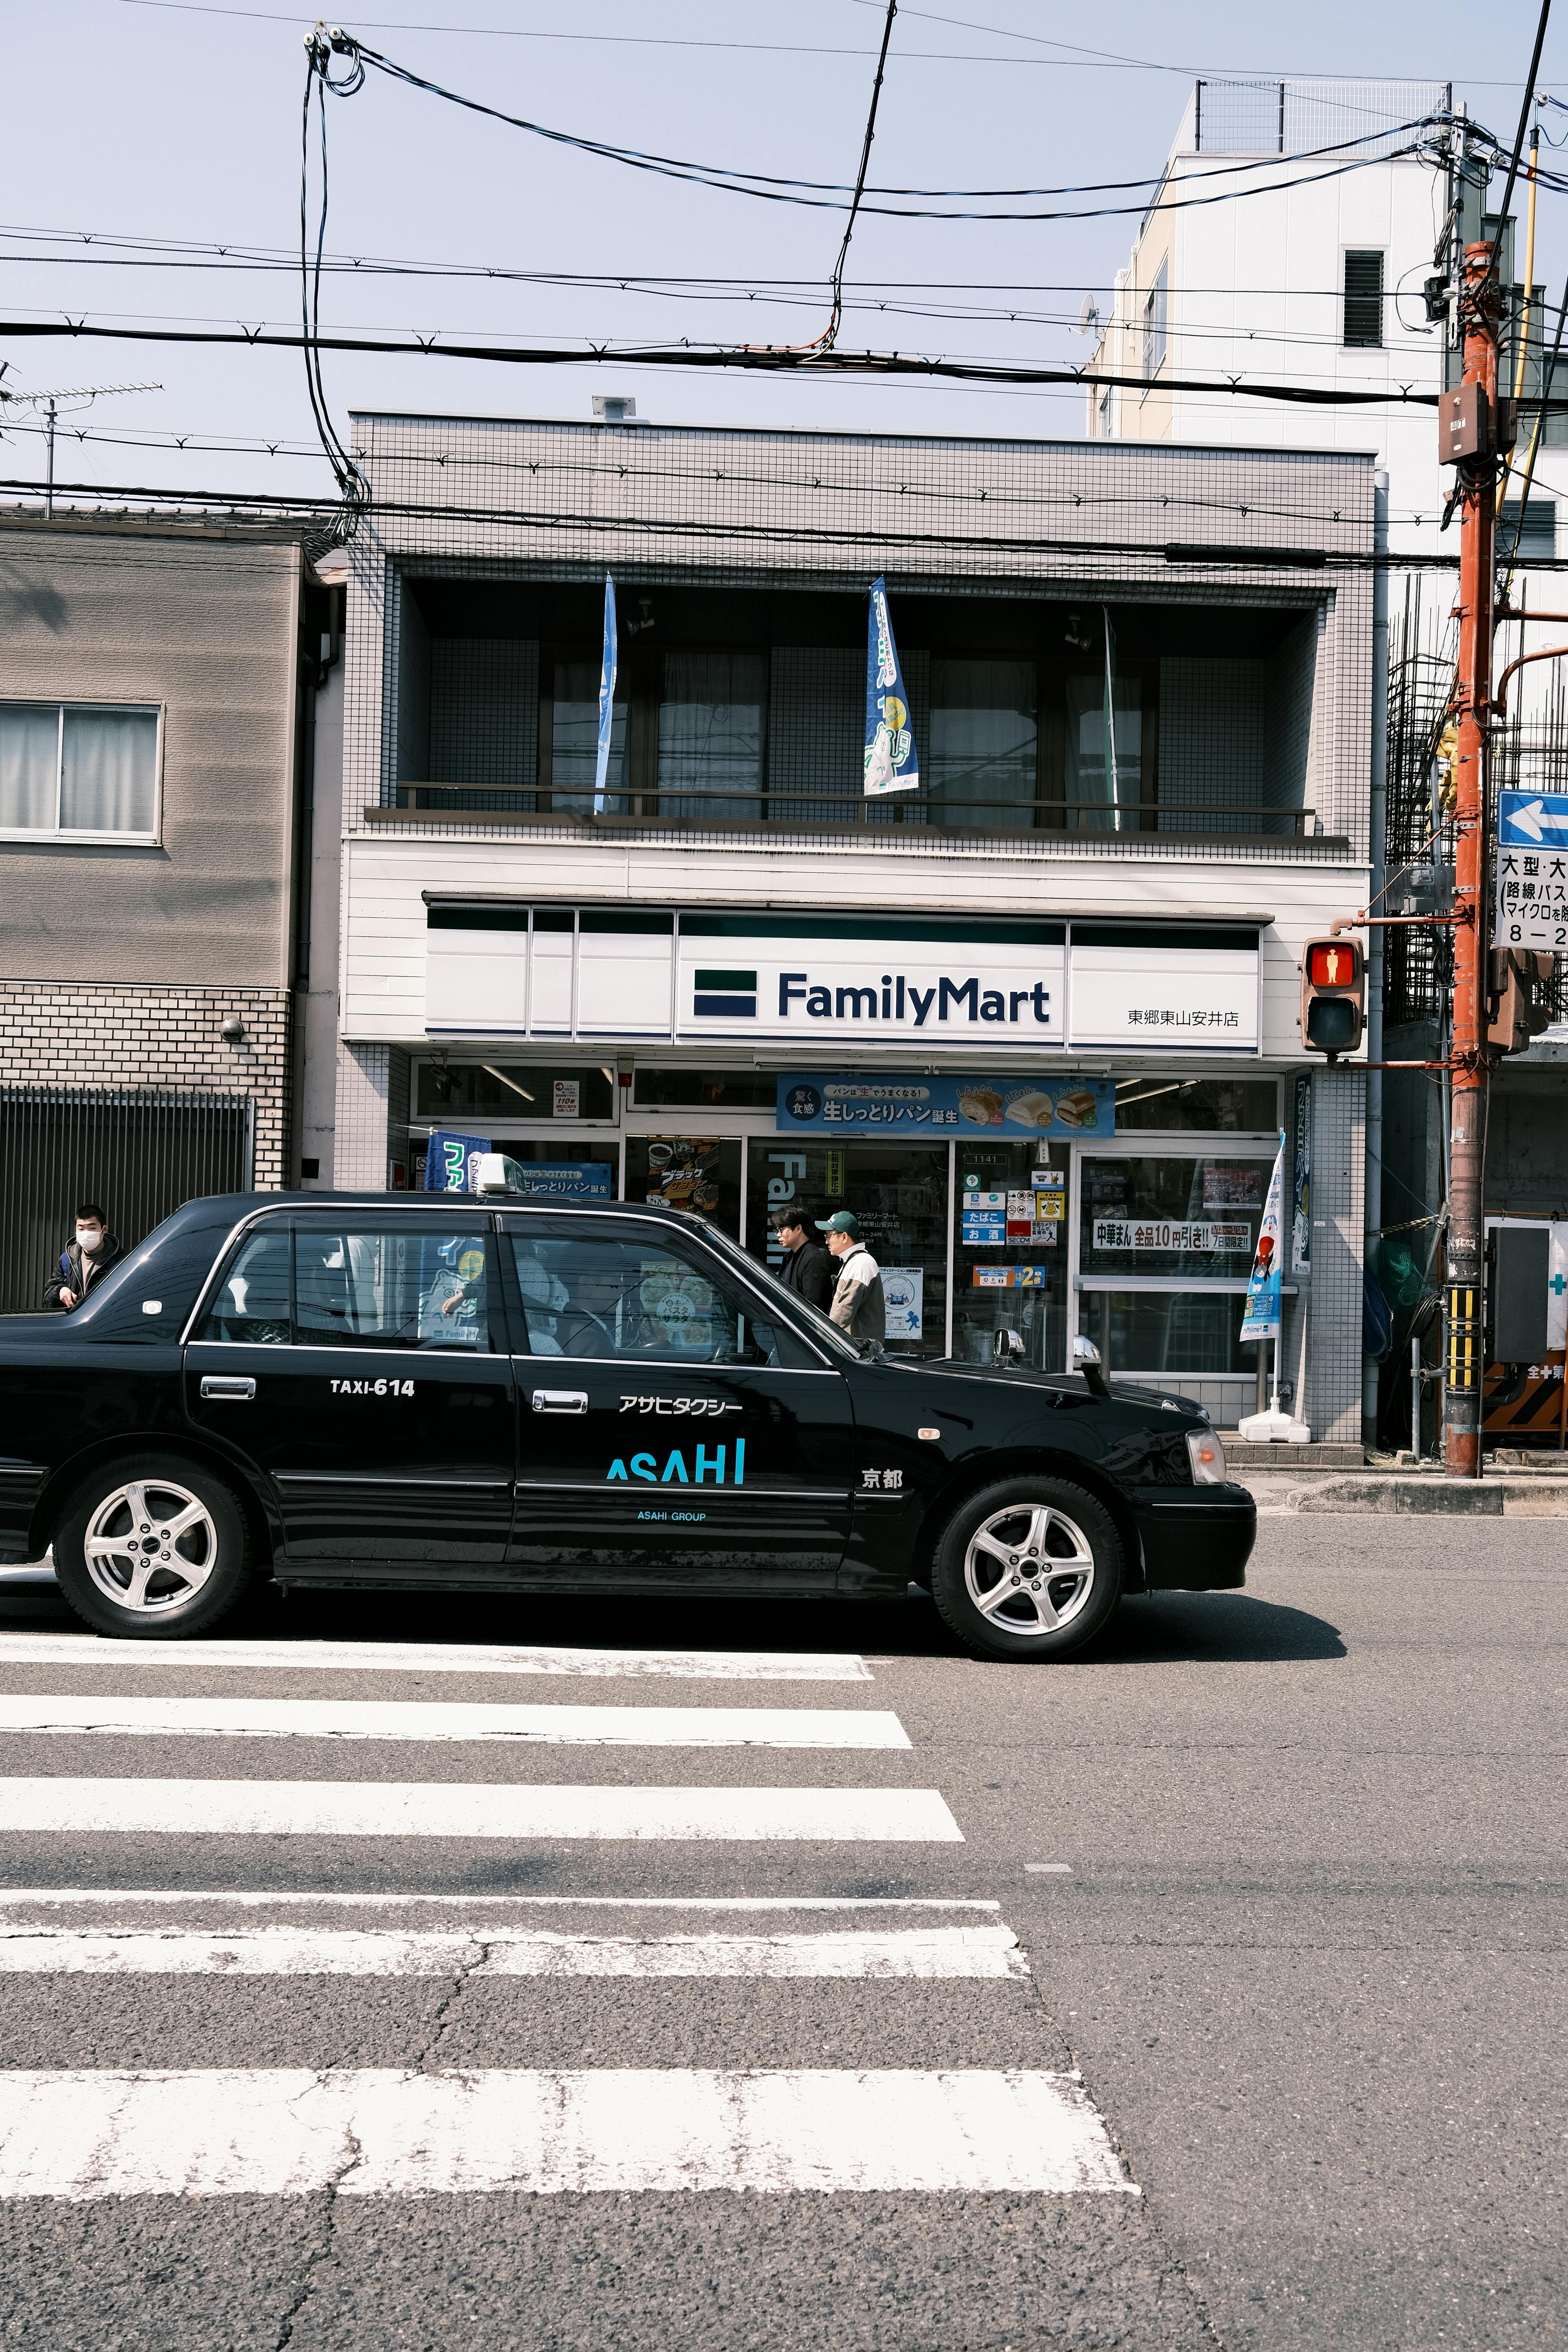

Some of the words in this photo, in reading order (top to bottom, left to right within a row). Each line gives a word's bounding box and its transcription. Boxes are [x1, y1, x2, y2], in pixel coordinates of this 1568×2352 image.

[1452, 418, 1464, 430] 40T
[888, 779, 914, 790] FamilyMart
[778, 972, 1050, 1027] FamilyMart
[1128, 1009, 1239, 1027] 東郷東山安井店
[795, 1090, 812, 1102] 驚く
[792, 1103, 815, 1114] 食感
[823, 1100, 958, 1124] 生しっとりパン誕生
[443, 1141, 465, 1191] ファ
[662, 1168, 704, 1185] ブラック
[671, 1180, 707, 1192] サンダー
[969, 1213, 998, 1223] たばこ
[1097, 1224, 1132, 1247] 中華まん
[1213, 1234, 1248, 1248] 7日間限定!!
[663, 1306, 688, 1315] パスタ
[663, 1314, 690, 1323] サラダ
[330, 1379, 415, 1396] TAXI-614
[619, 1396, 743, 1416] アサヒタクシー
[606, 1438, 746, 1485] ASAHI
[862, 1468, 903, 1489] 京都
[637, 1512, 667, 1521] ASAHI
[671, 1512, 706, 1521] GROUP
